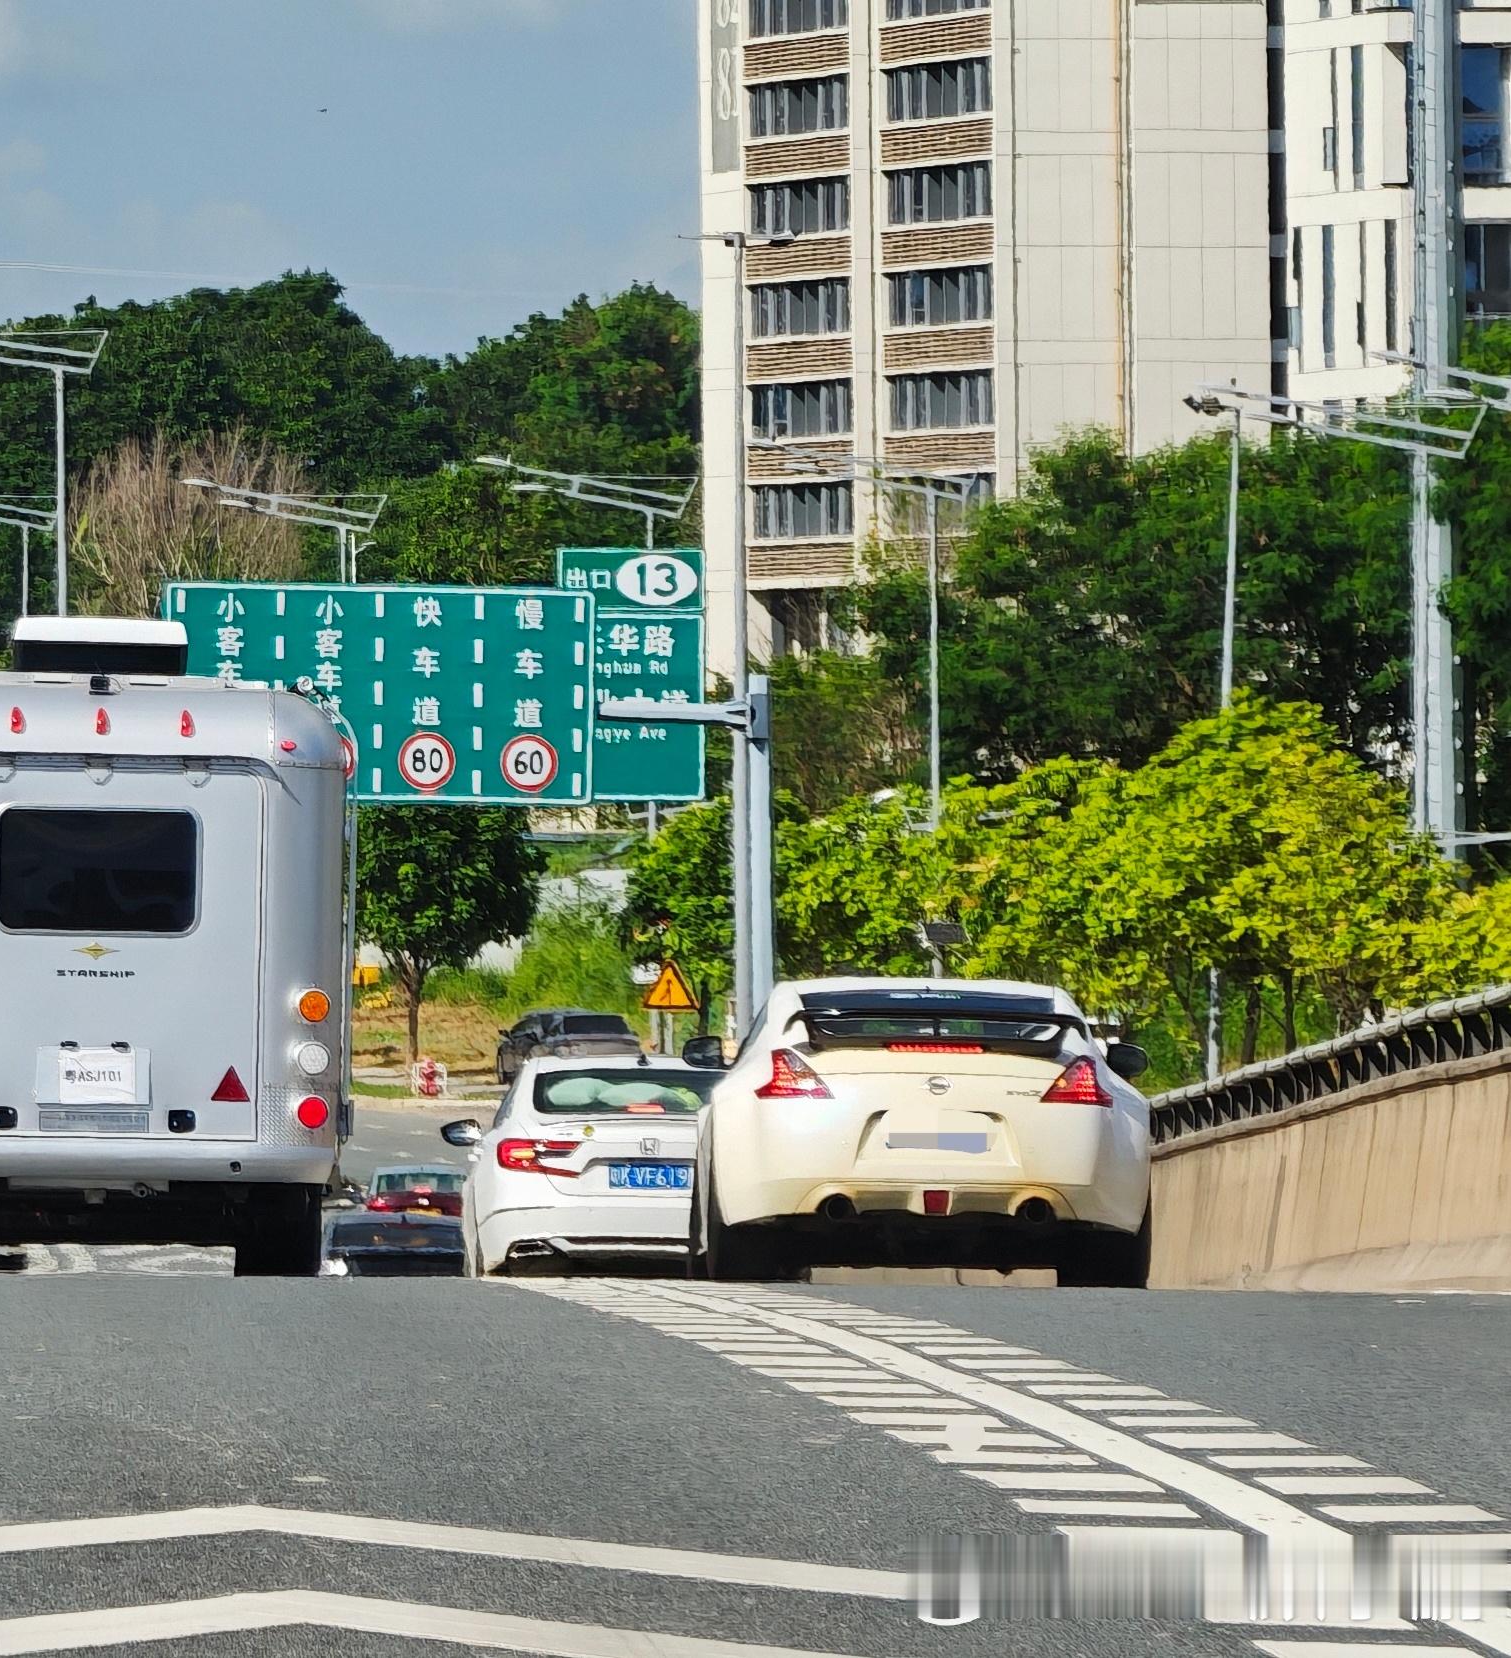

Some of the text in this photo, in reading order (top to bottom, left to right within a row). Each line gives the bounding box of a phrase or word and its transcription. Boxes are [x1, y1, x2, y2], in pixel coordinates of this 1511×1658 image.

[566, 567, 611, 589] 出口
[636, 562, 678, 597] 13
[596, 624, 675, 657] 华路
[410, 595, 442, 725] 快车道
[514, 598, 544, 728] 慢车道
[649, 660, 668, 676] Rd
[639, 726, 667, 740] Ave
[412, 748, 443, 773] 80
[514, 750, 544, 775] 60
[56, 969, 136, 978] STARSHIP
